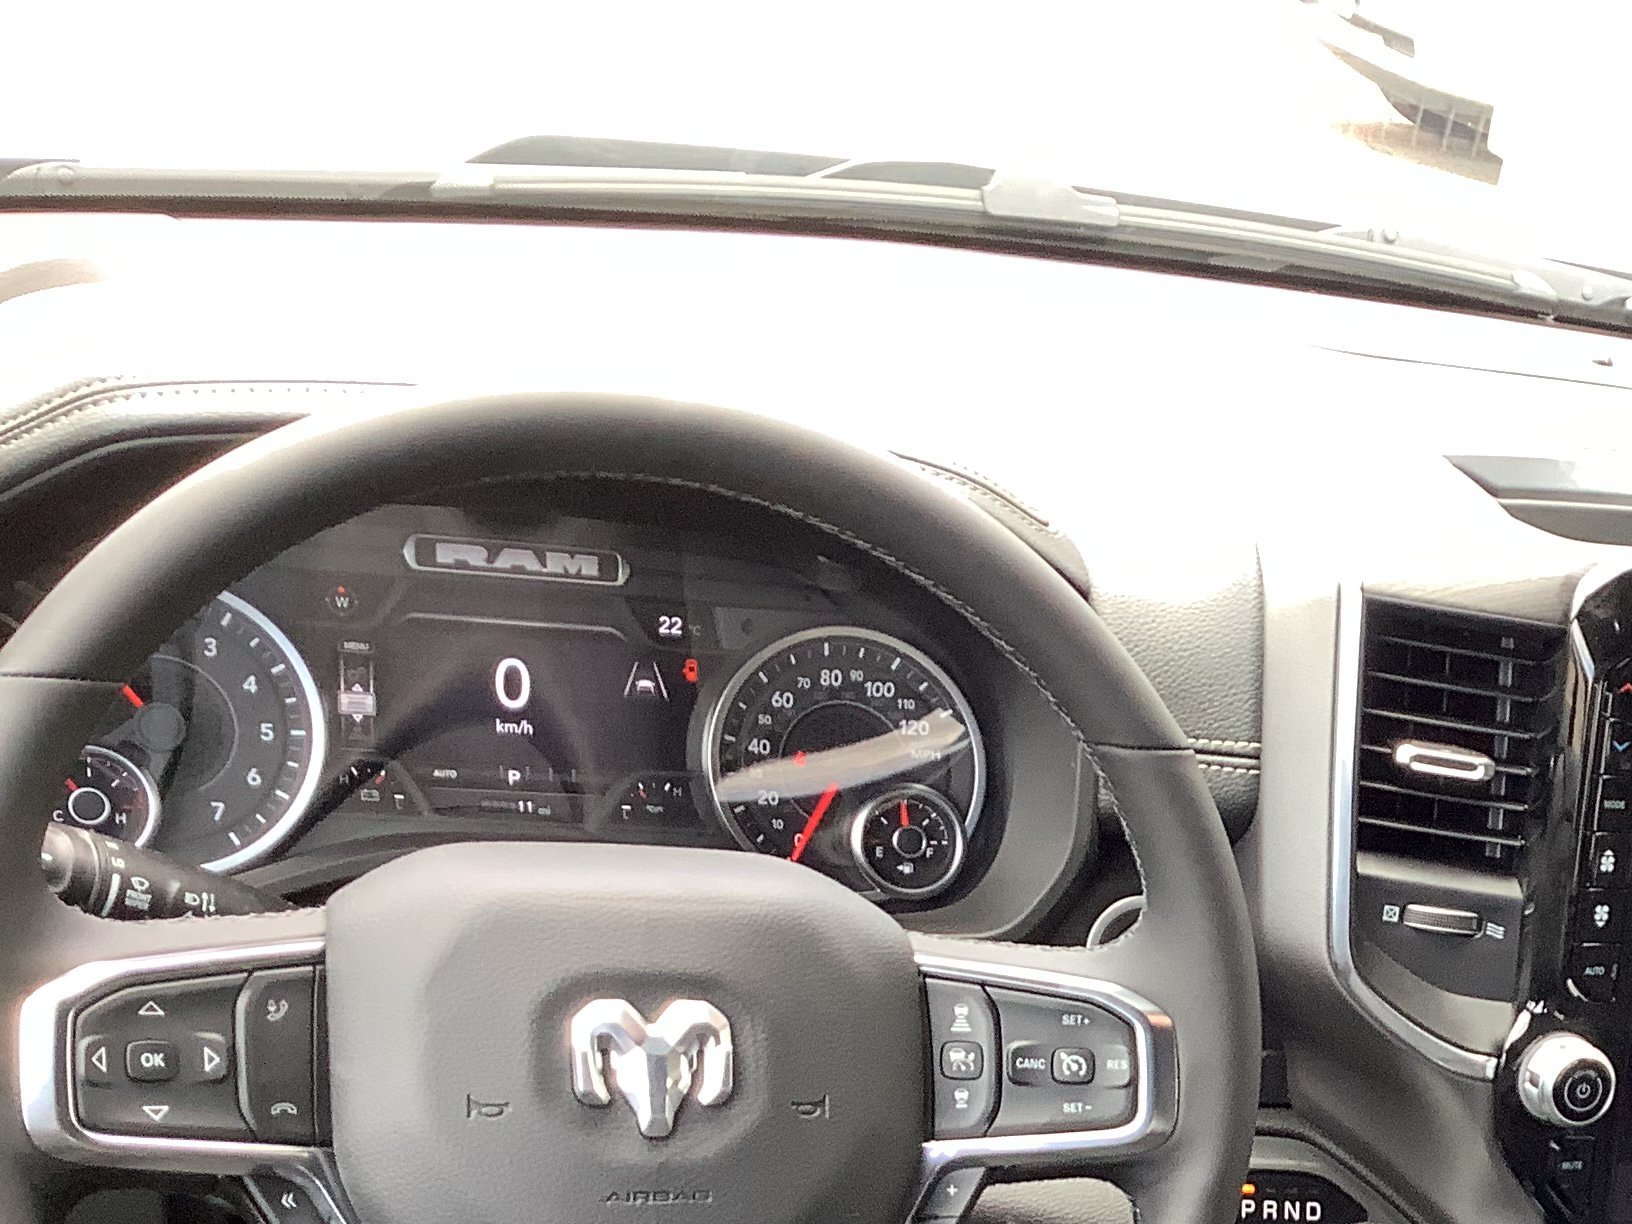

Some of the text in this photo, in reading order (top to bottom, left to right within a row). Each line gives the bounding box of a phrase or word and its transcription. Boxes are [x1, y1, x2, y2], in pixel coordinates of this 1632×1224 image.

[436, 542, 599, 576] RAM
[658, 616, 683, 635] 22
[203, 637, 218, 657] 3
[495, 657, 531, 709] 0
[796, 676, 811, 689] 70
[820, 669, 843, 687] 80
[849, 669, 864, 682] 90
[242, 675, 258, 694] 4
[863, 681, 896, 698] 100
[770, 691, 794, 709] 60
[896, 698, 916, 710] 110
[494, 718, 535, 736] km/h
[757, 713, 772, 725] 50
[898, 719, 930, 736] 120
[259, 722, 275, 741] 5
[747, 738, 771, 755] 40
[246, 767, 262, 786] 6
[432, 768, 458, 780] AUTO
[507, 769, 521, 786] P
[757, 789, 780, 806] 20
[210, 801, 225, 821] 7
[517, 799, 533, 814] 11
[52, 809, 65, 822] C
[114, 811, 127, 825] H
[771, 818, 784, 830] 10
[875, 846, 884, 859] E
[925, 847, 935, 858] F
[1583, 966, 1606, 976] AUTO
[140, 1052, 166, 1068] OK
[1015, 1057, 1047, 1070] CANC
[1105, 1058, 1128, 1070] RES
